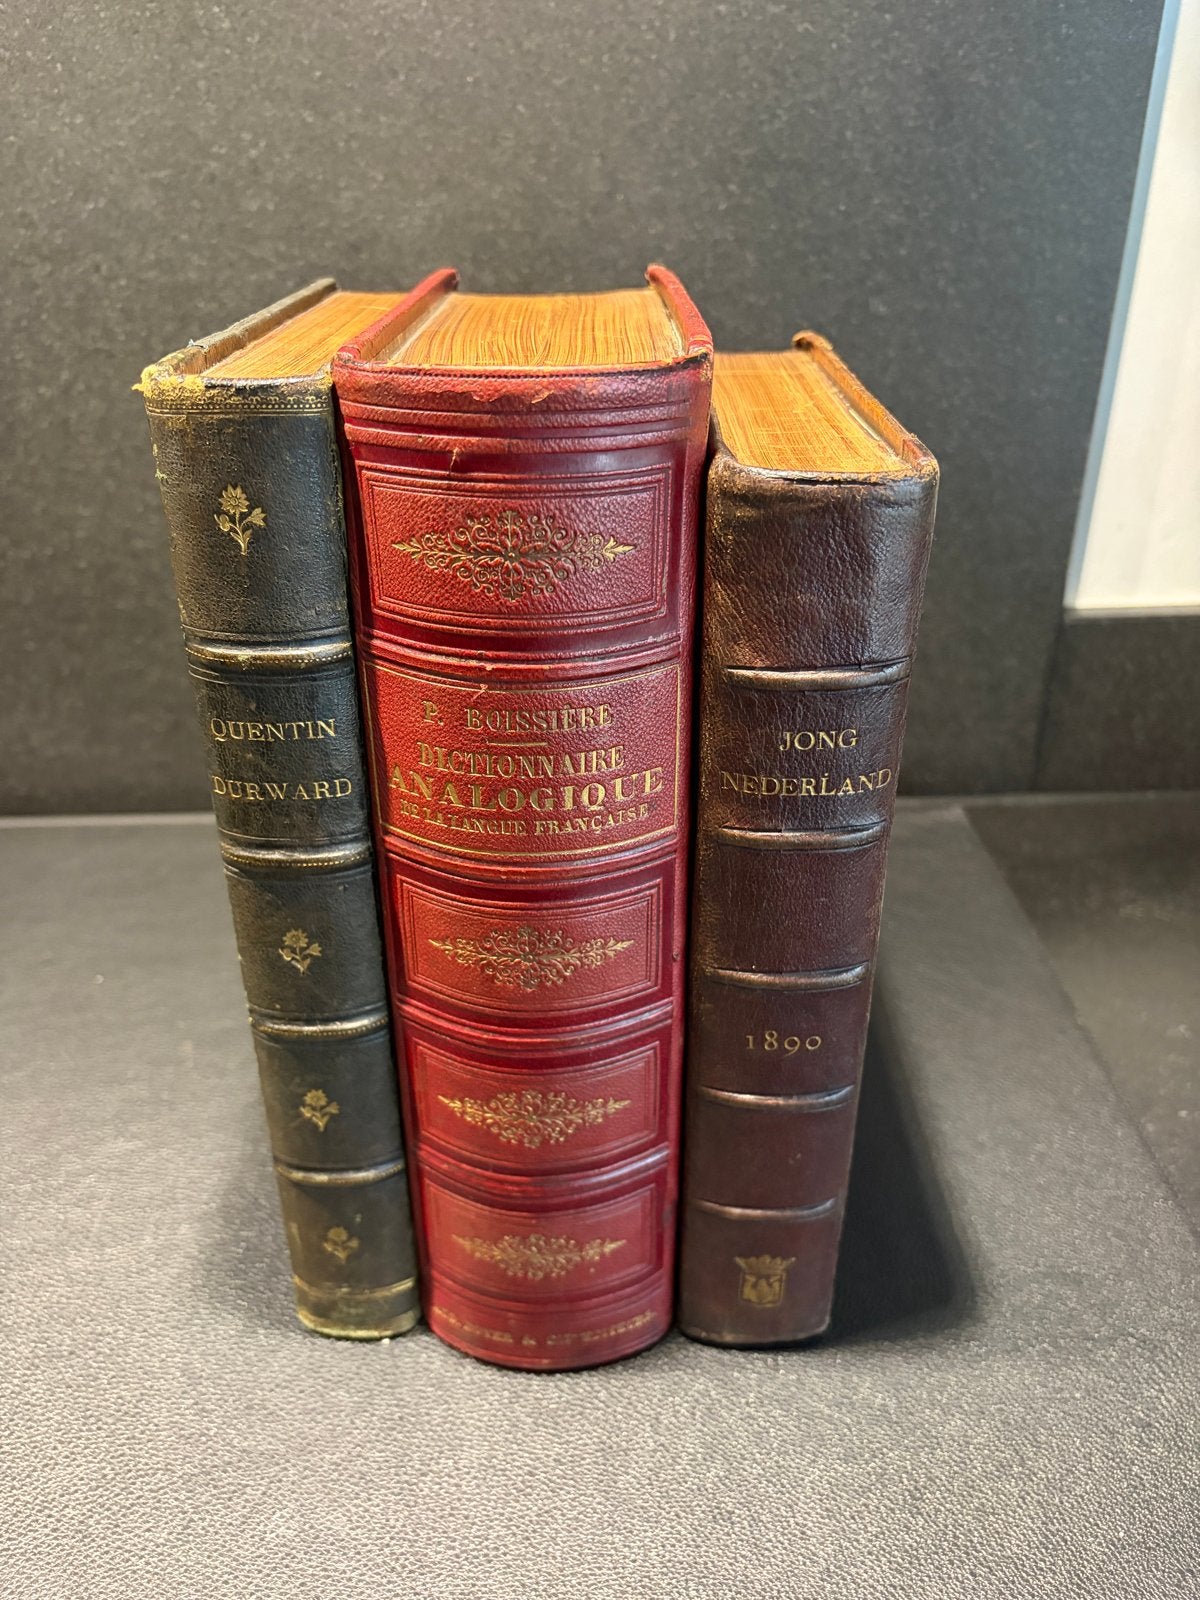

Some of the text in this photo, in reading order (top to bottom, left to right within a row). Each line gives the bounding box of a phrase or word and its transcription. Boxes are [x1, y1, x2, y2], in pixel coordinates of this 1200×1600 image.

[210, 718, 336, 742] QUENTIN
[422, 700, 614, 733] P. BOISSIÈRE
[780, 729, 858, 751] JONG
[417, 742, 625, 779] DICTIONNAIRE
[212, 775, 352, 800] DURWARD
[388, 765, 664, 812] ANALOGIQUE
[721, 768, 892, 796] NEDERLAND
[447, 814, 527, 836] LANGUE
[534, 803, 650, 835] FRANÇAISE
[745, 1030, 822, 1057] 1890
